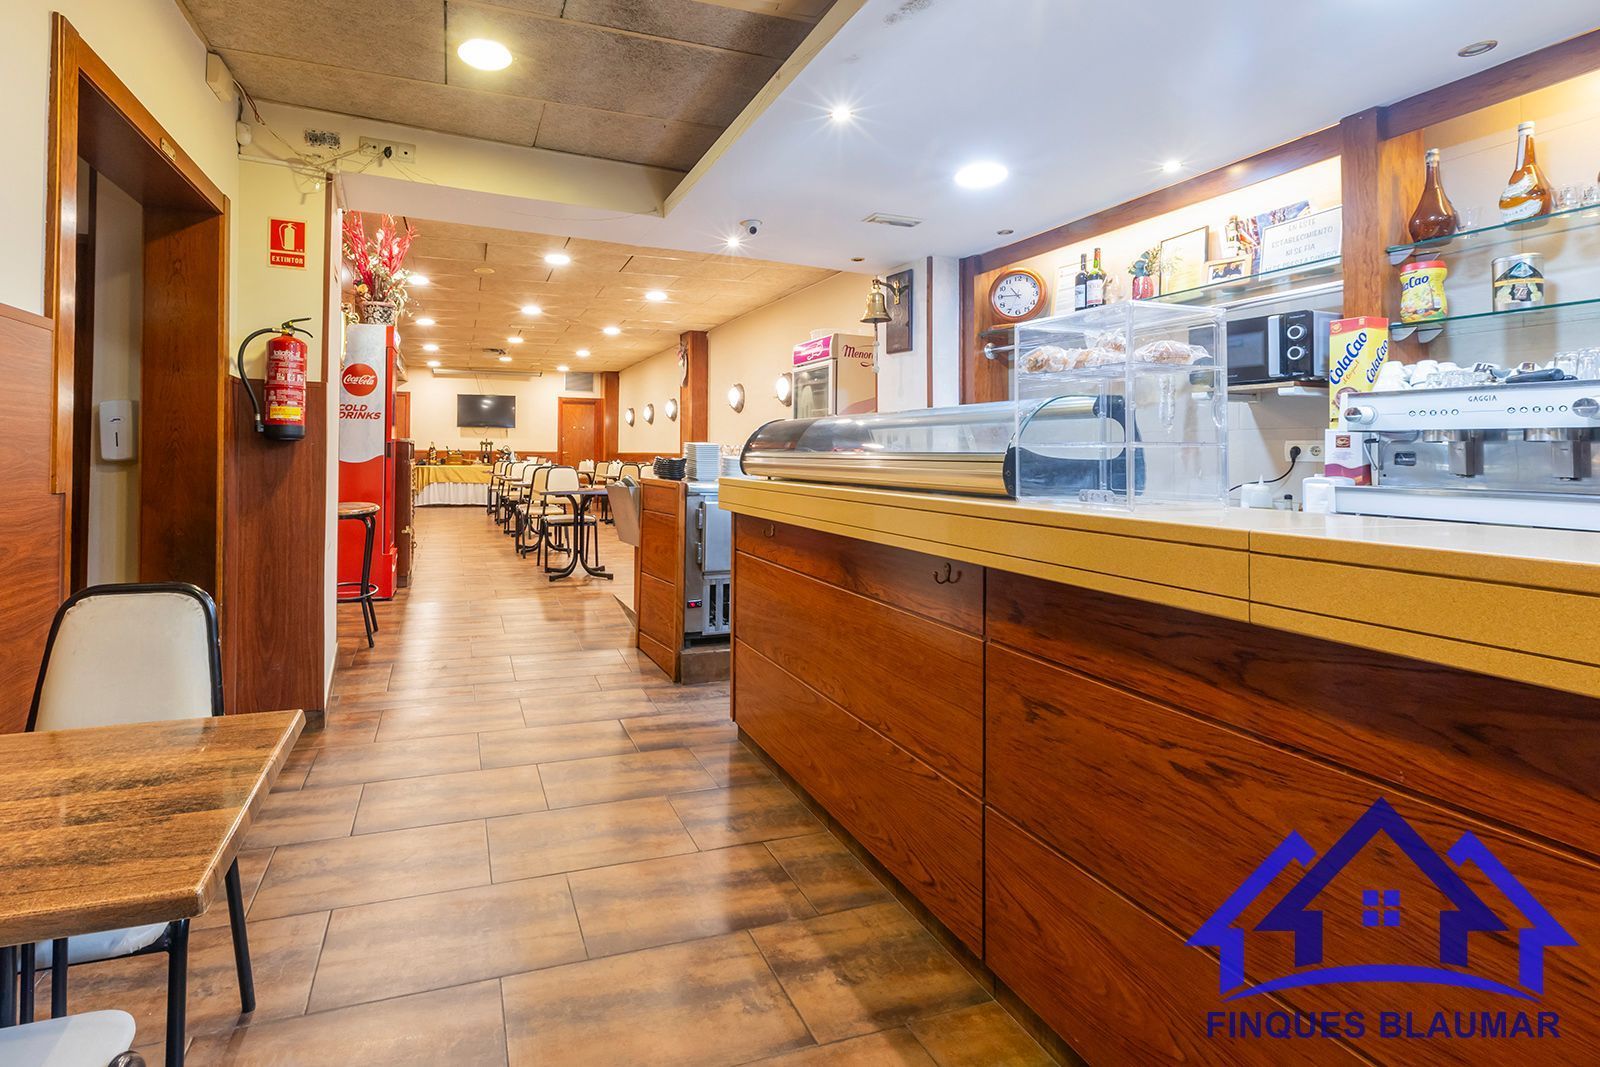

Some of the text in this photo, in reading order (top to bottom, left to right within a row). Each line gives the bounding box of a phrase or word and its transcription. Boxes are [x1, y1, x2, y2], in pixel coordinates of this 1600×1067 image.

[271, 255, 304, 265] EXTINTOR
[1329, 331, 1367, 385] ColaCao
[1366, 339, 1388, 384] ColaCao
[343, 373, 376, 385] Coca-Cola
[1467, 394, 1498, 402] GAGGIA
[339, 403, 368, 412] COLD
[339, 411, 382, 420] DRINKS
